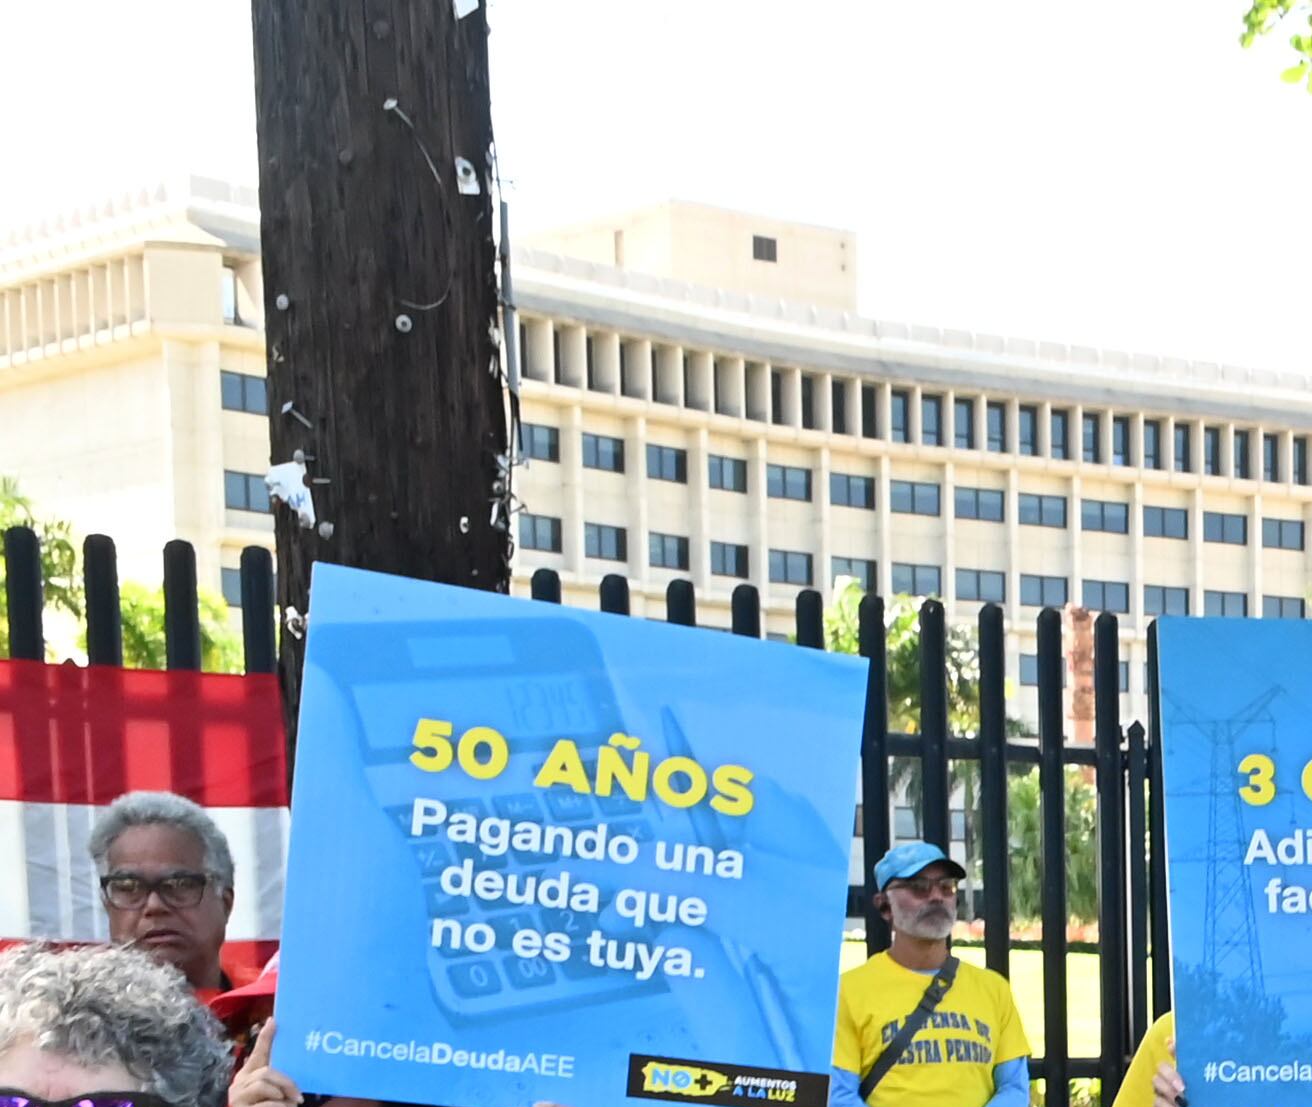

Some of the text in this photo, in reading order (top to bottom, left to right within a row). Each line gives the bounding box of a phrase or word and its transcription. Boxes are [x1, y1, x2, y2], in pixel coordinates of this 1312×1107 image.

[409, 718, 755, 816] 50 AÑOS
[1237, 754, 1276, 807] 3
[410, 797, 744, 879] Pagando una
[440, 859, 708, 927] deuda que
[431, 917, 705, 980] no es tuya.
[304, 1029, 576, 1079] #CancelaDeudaAEE
[733, 1086, 796, 1102] A LA LUZ
